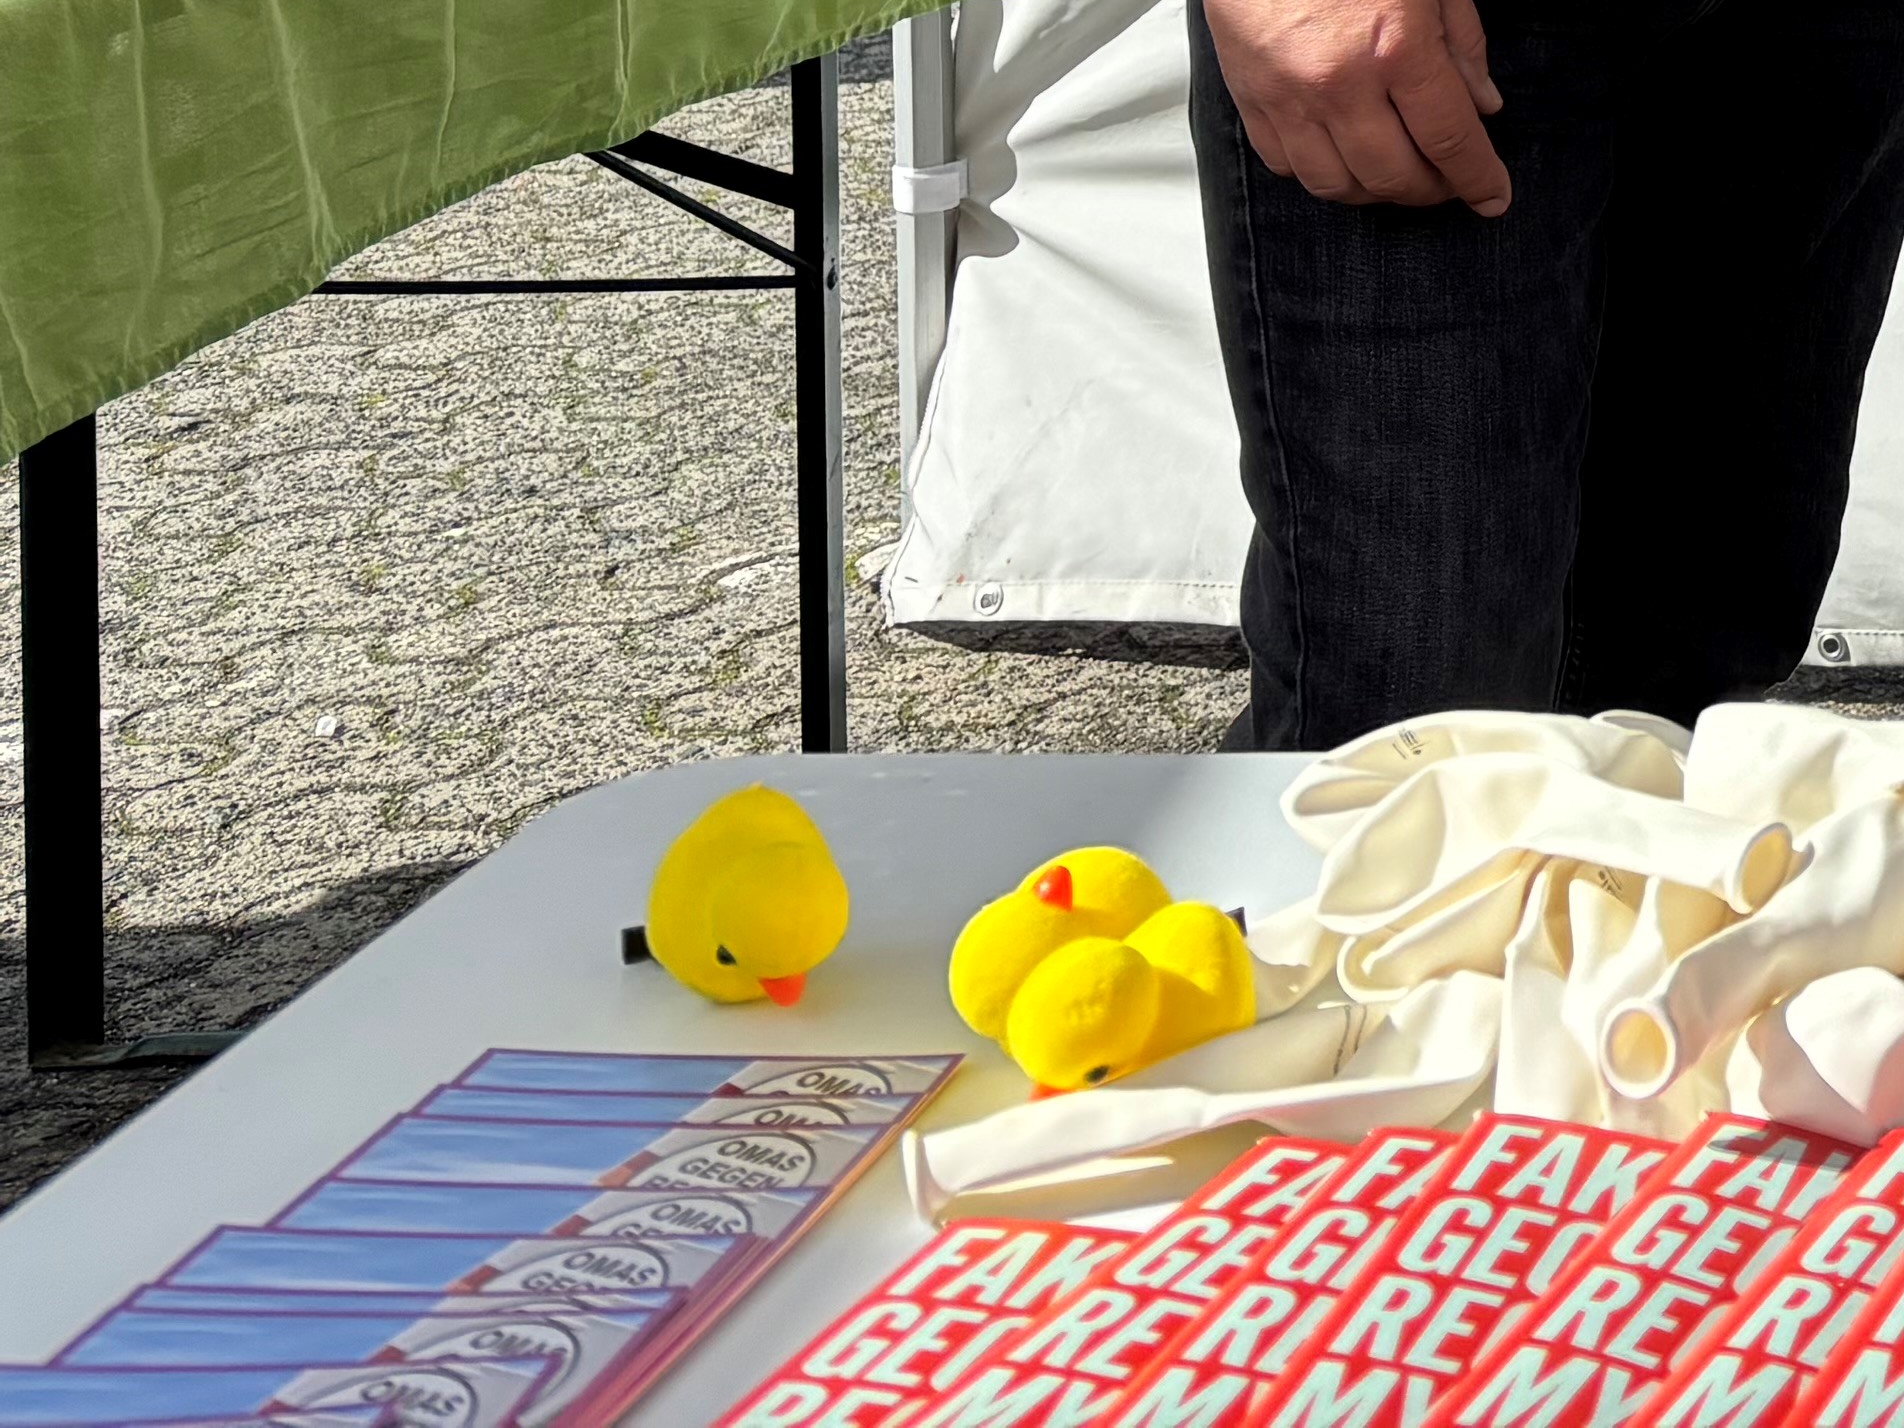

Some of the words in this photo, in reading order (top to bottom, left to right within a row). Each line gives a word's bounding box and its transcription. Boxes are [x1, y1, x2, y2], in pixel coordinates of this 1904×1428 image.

[716, 1139, 806, 1173] OMAS
[649, 1203, 742, 1235] OMAS
[562, 1251, 658, 1287] OMAS
